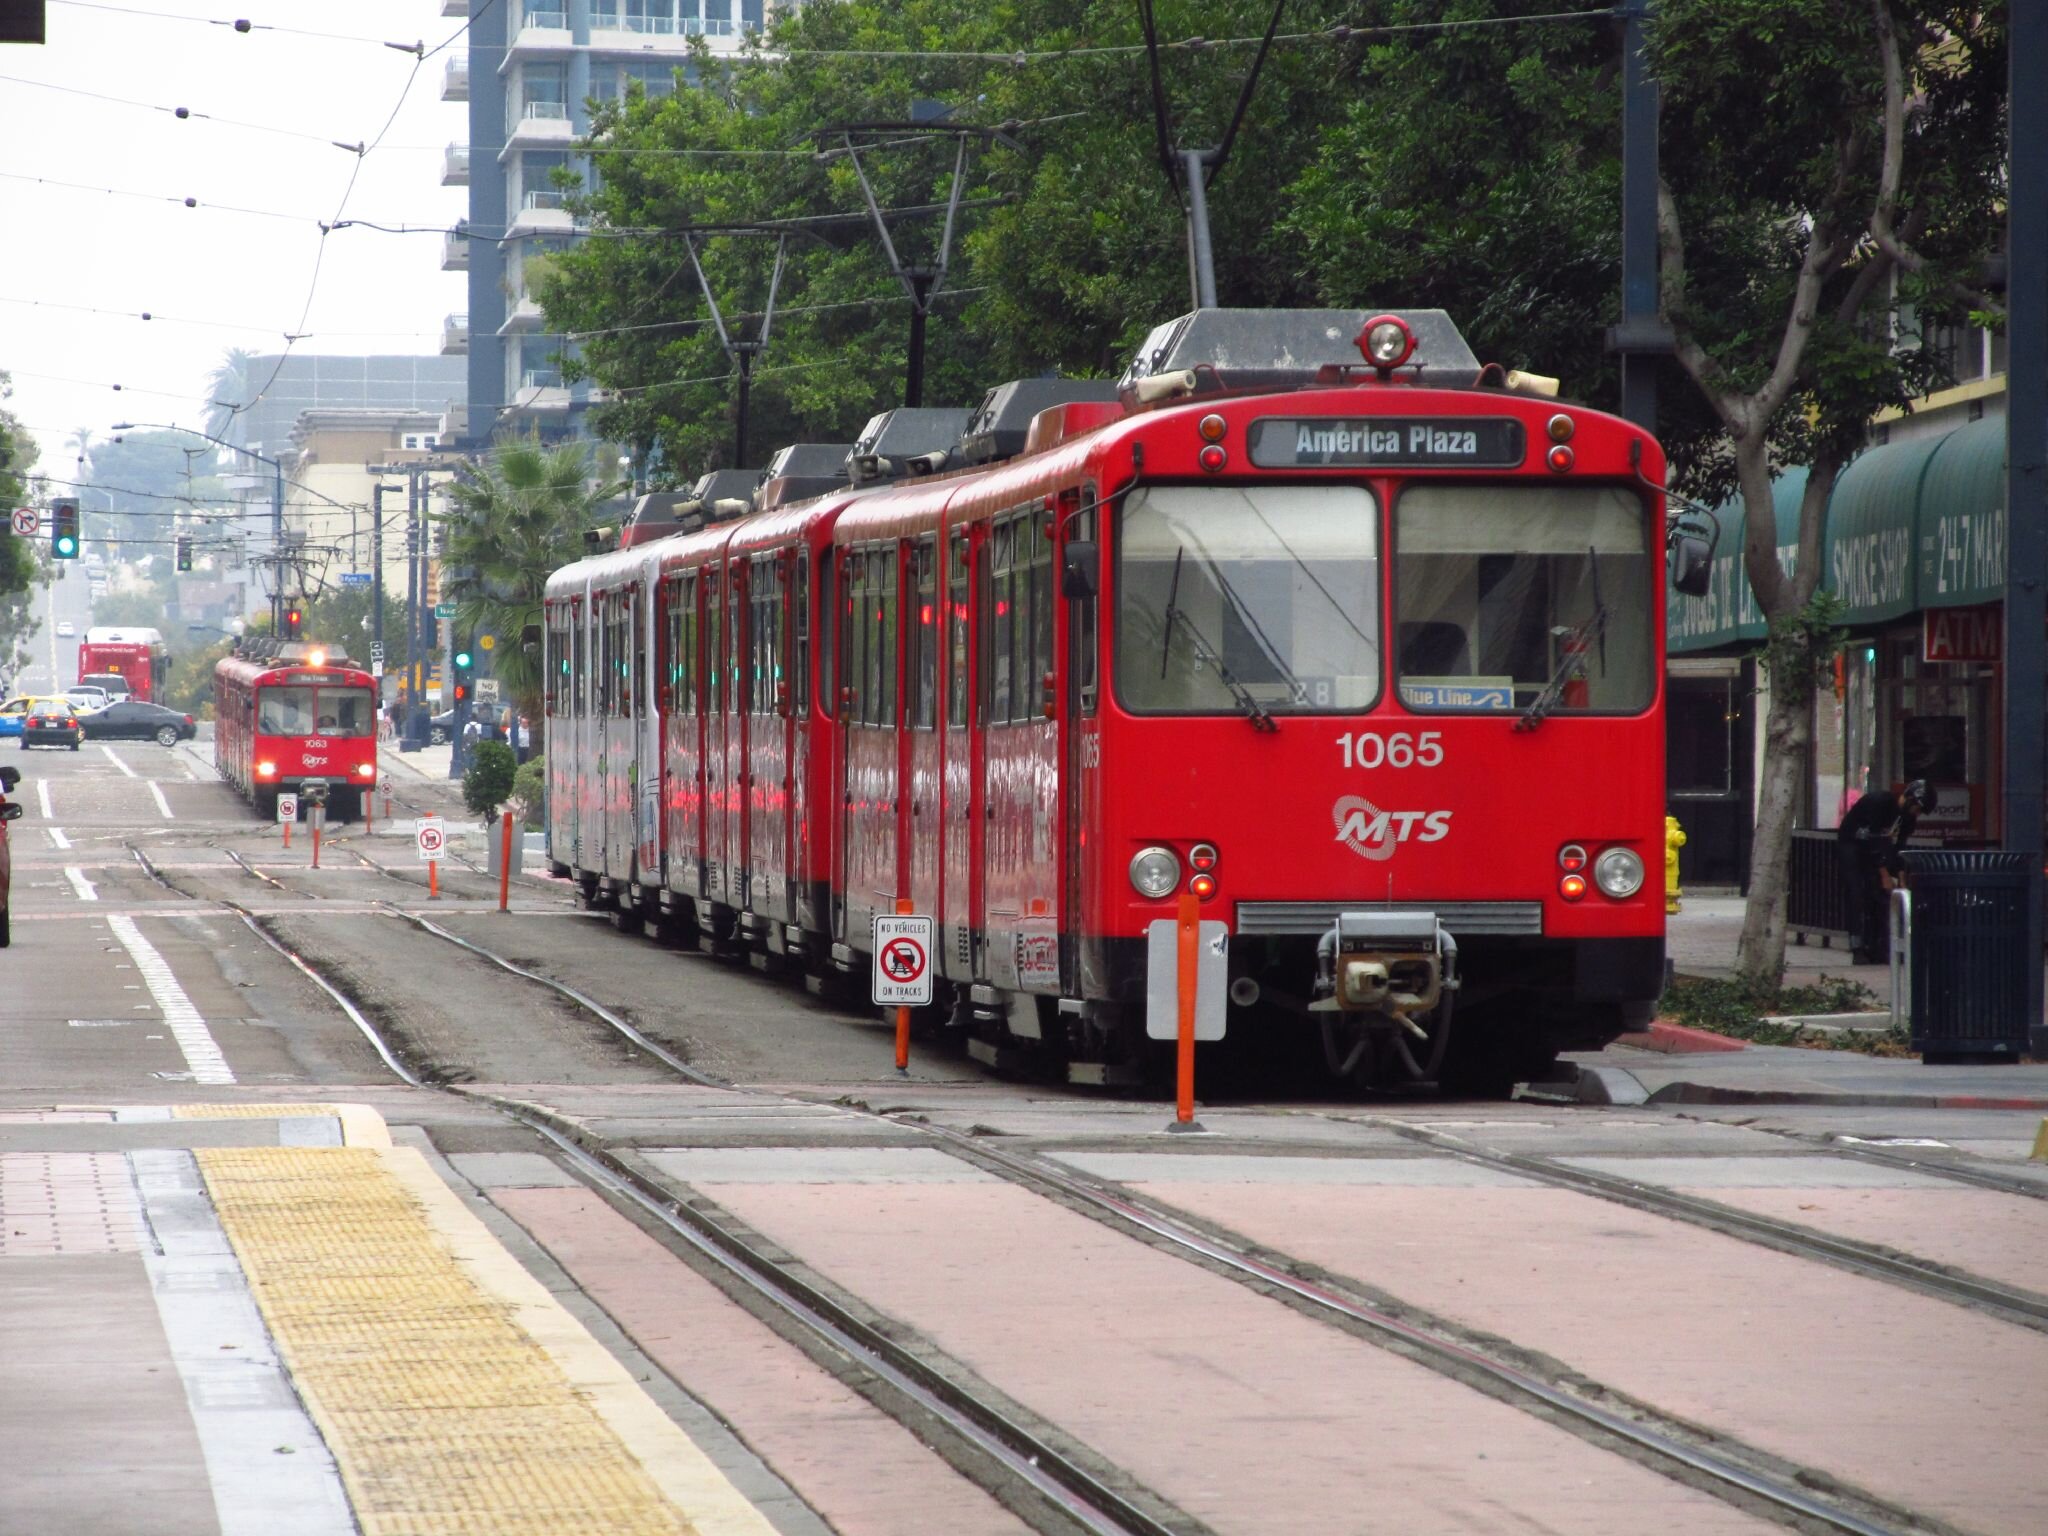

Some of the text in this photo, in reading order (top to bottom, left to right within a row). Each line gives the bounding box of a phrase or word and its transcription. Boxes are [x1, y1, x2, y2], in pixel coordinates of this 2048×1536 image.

[1409, 425, 1476, 454] Plaza
[1833, 532, 1877, 608] SMOKE
[1880, 526, 1908, 604] SHOP
[1931, 611, 1996, 656] ATM
[1438, 688, 1472, 706] Line
[304, 739, 327, 748] 1063
[1336, 731, 1444, 768] 1065
[304, 755, 328, 766] MTS
[1334, 810, 1454, 842] MTS
[881, 923, 926, 933] NO VEHICLES
[882, 987, 922, 996] ON TRACKS
